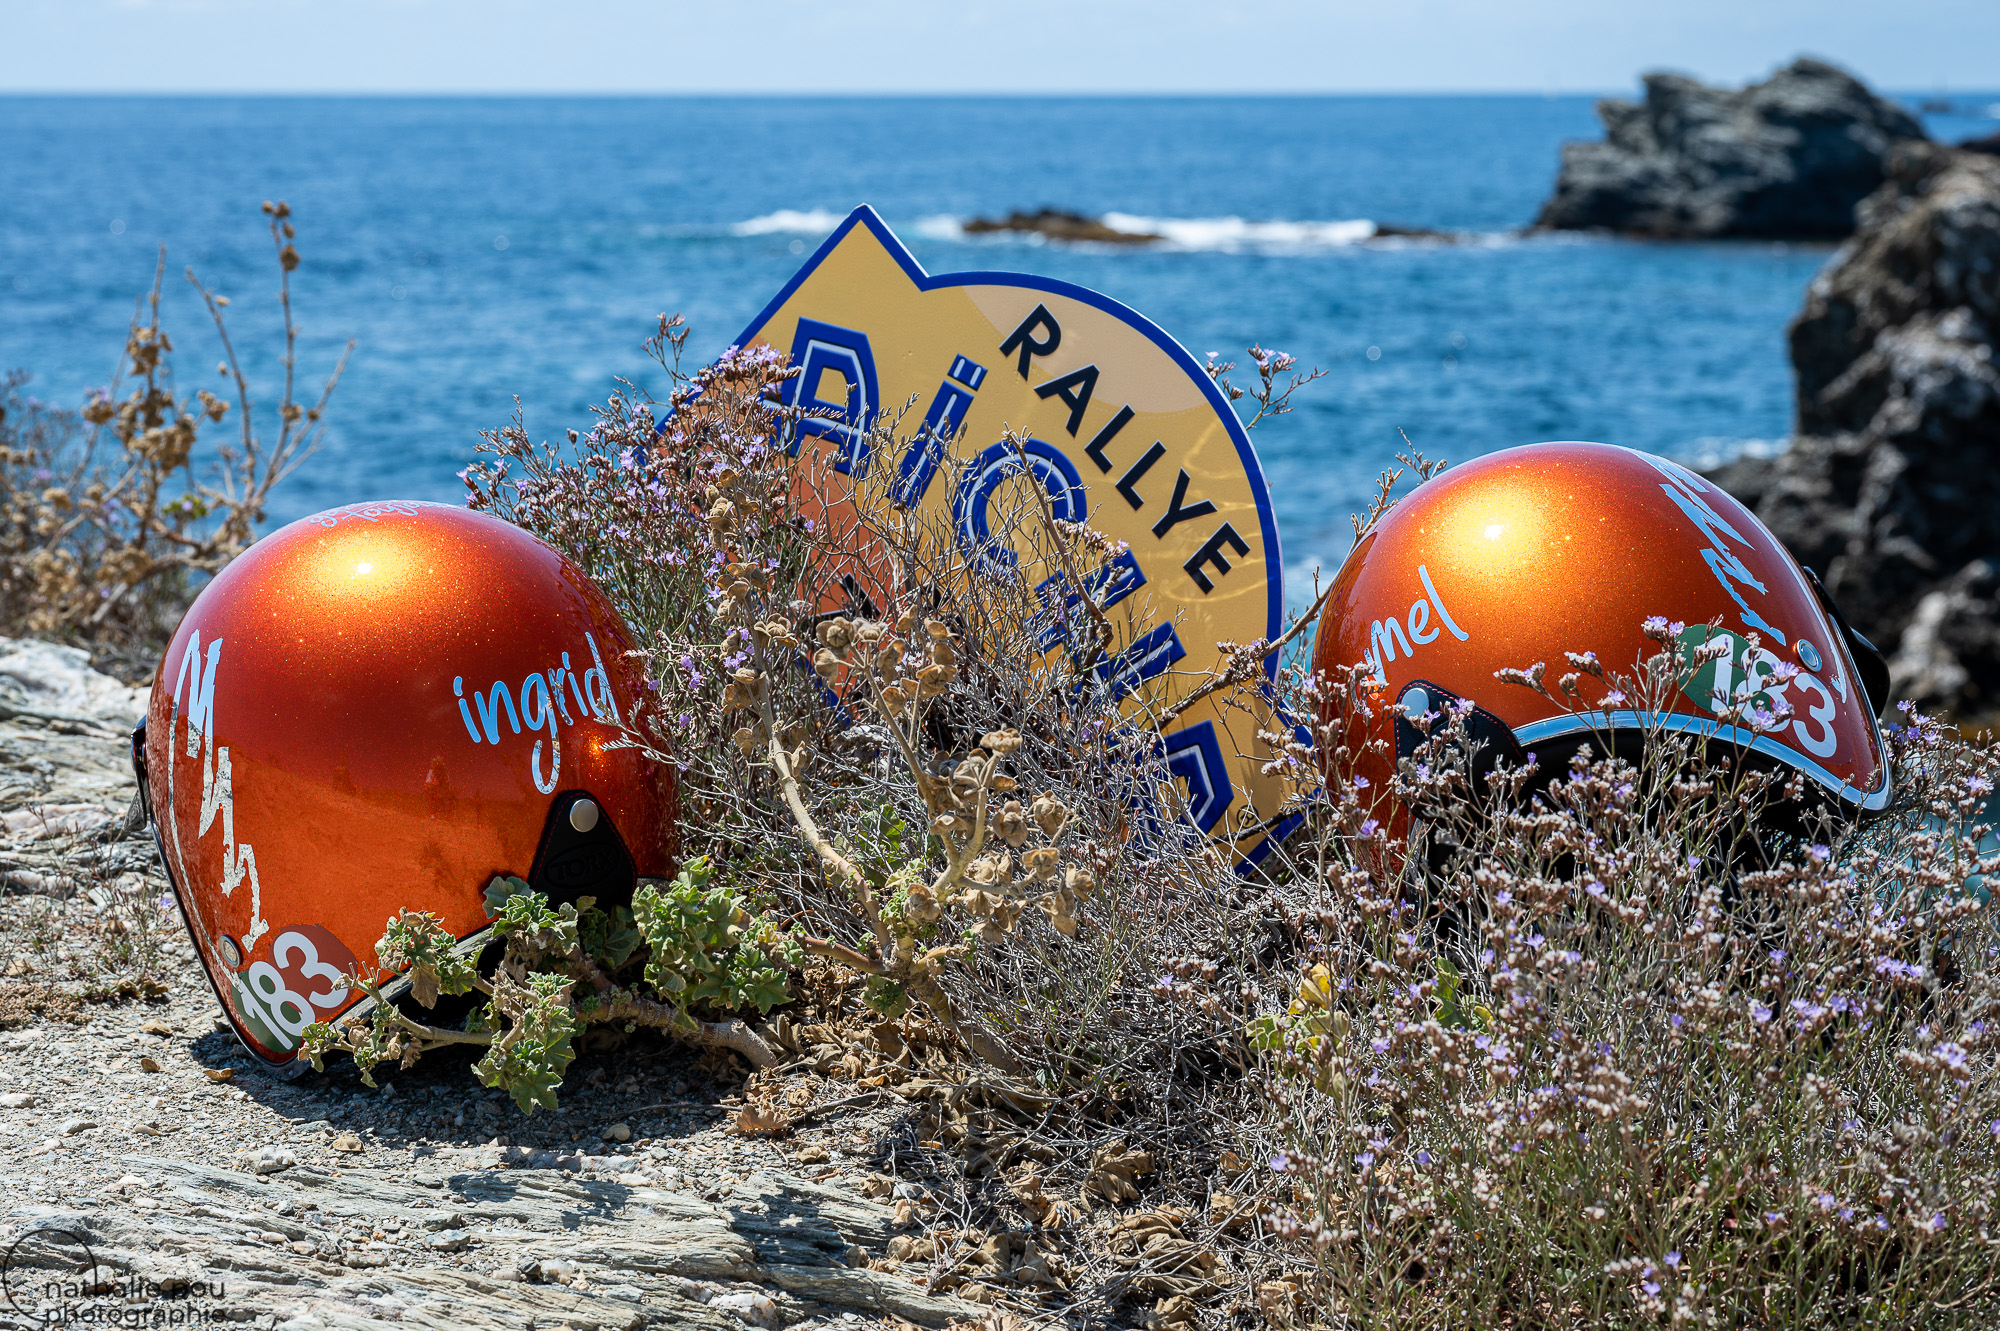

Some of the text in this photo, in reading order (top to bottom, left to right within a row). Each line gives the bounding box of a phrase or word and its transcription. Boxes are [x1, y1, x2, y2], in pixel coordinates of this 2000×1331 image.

[999, 302, 1250, 595] RALLYE
[453, 631, 621, 795] ingrid
[1704, 633, 1838, 758] 183
[238, 931, 343, 1051] 183
